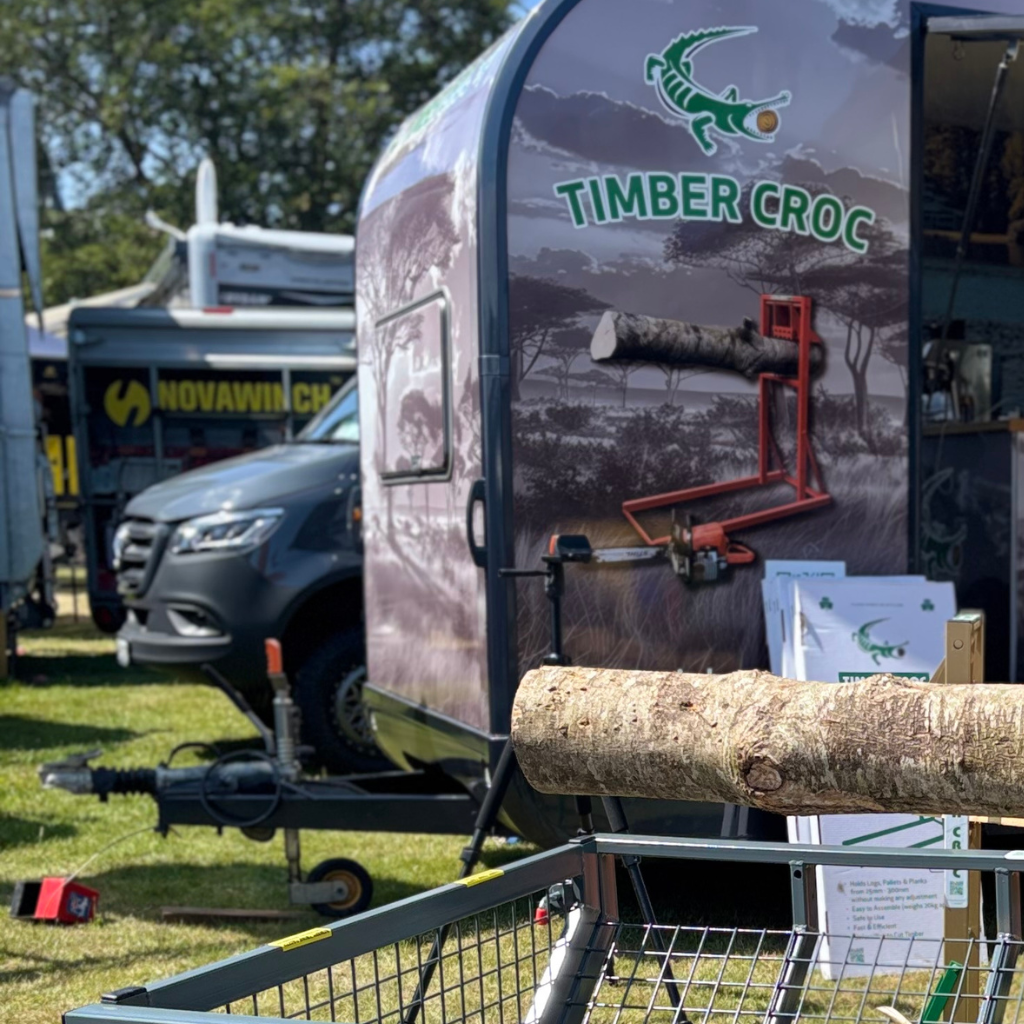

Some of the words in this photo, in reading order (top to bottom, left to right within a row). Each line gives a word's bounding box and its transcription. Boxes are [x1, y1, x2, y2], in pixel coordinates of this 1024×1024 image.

[554, 172, 742, 228] TIMBER
[751, 180, 875, 254] CROC
[157, 379, 332, 414] NOVAWINCH
